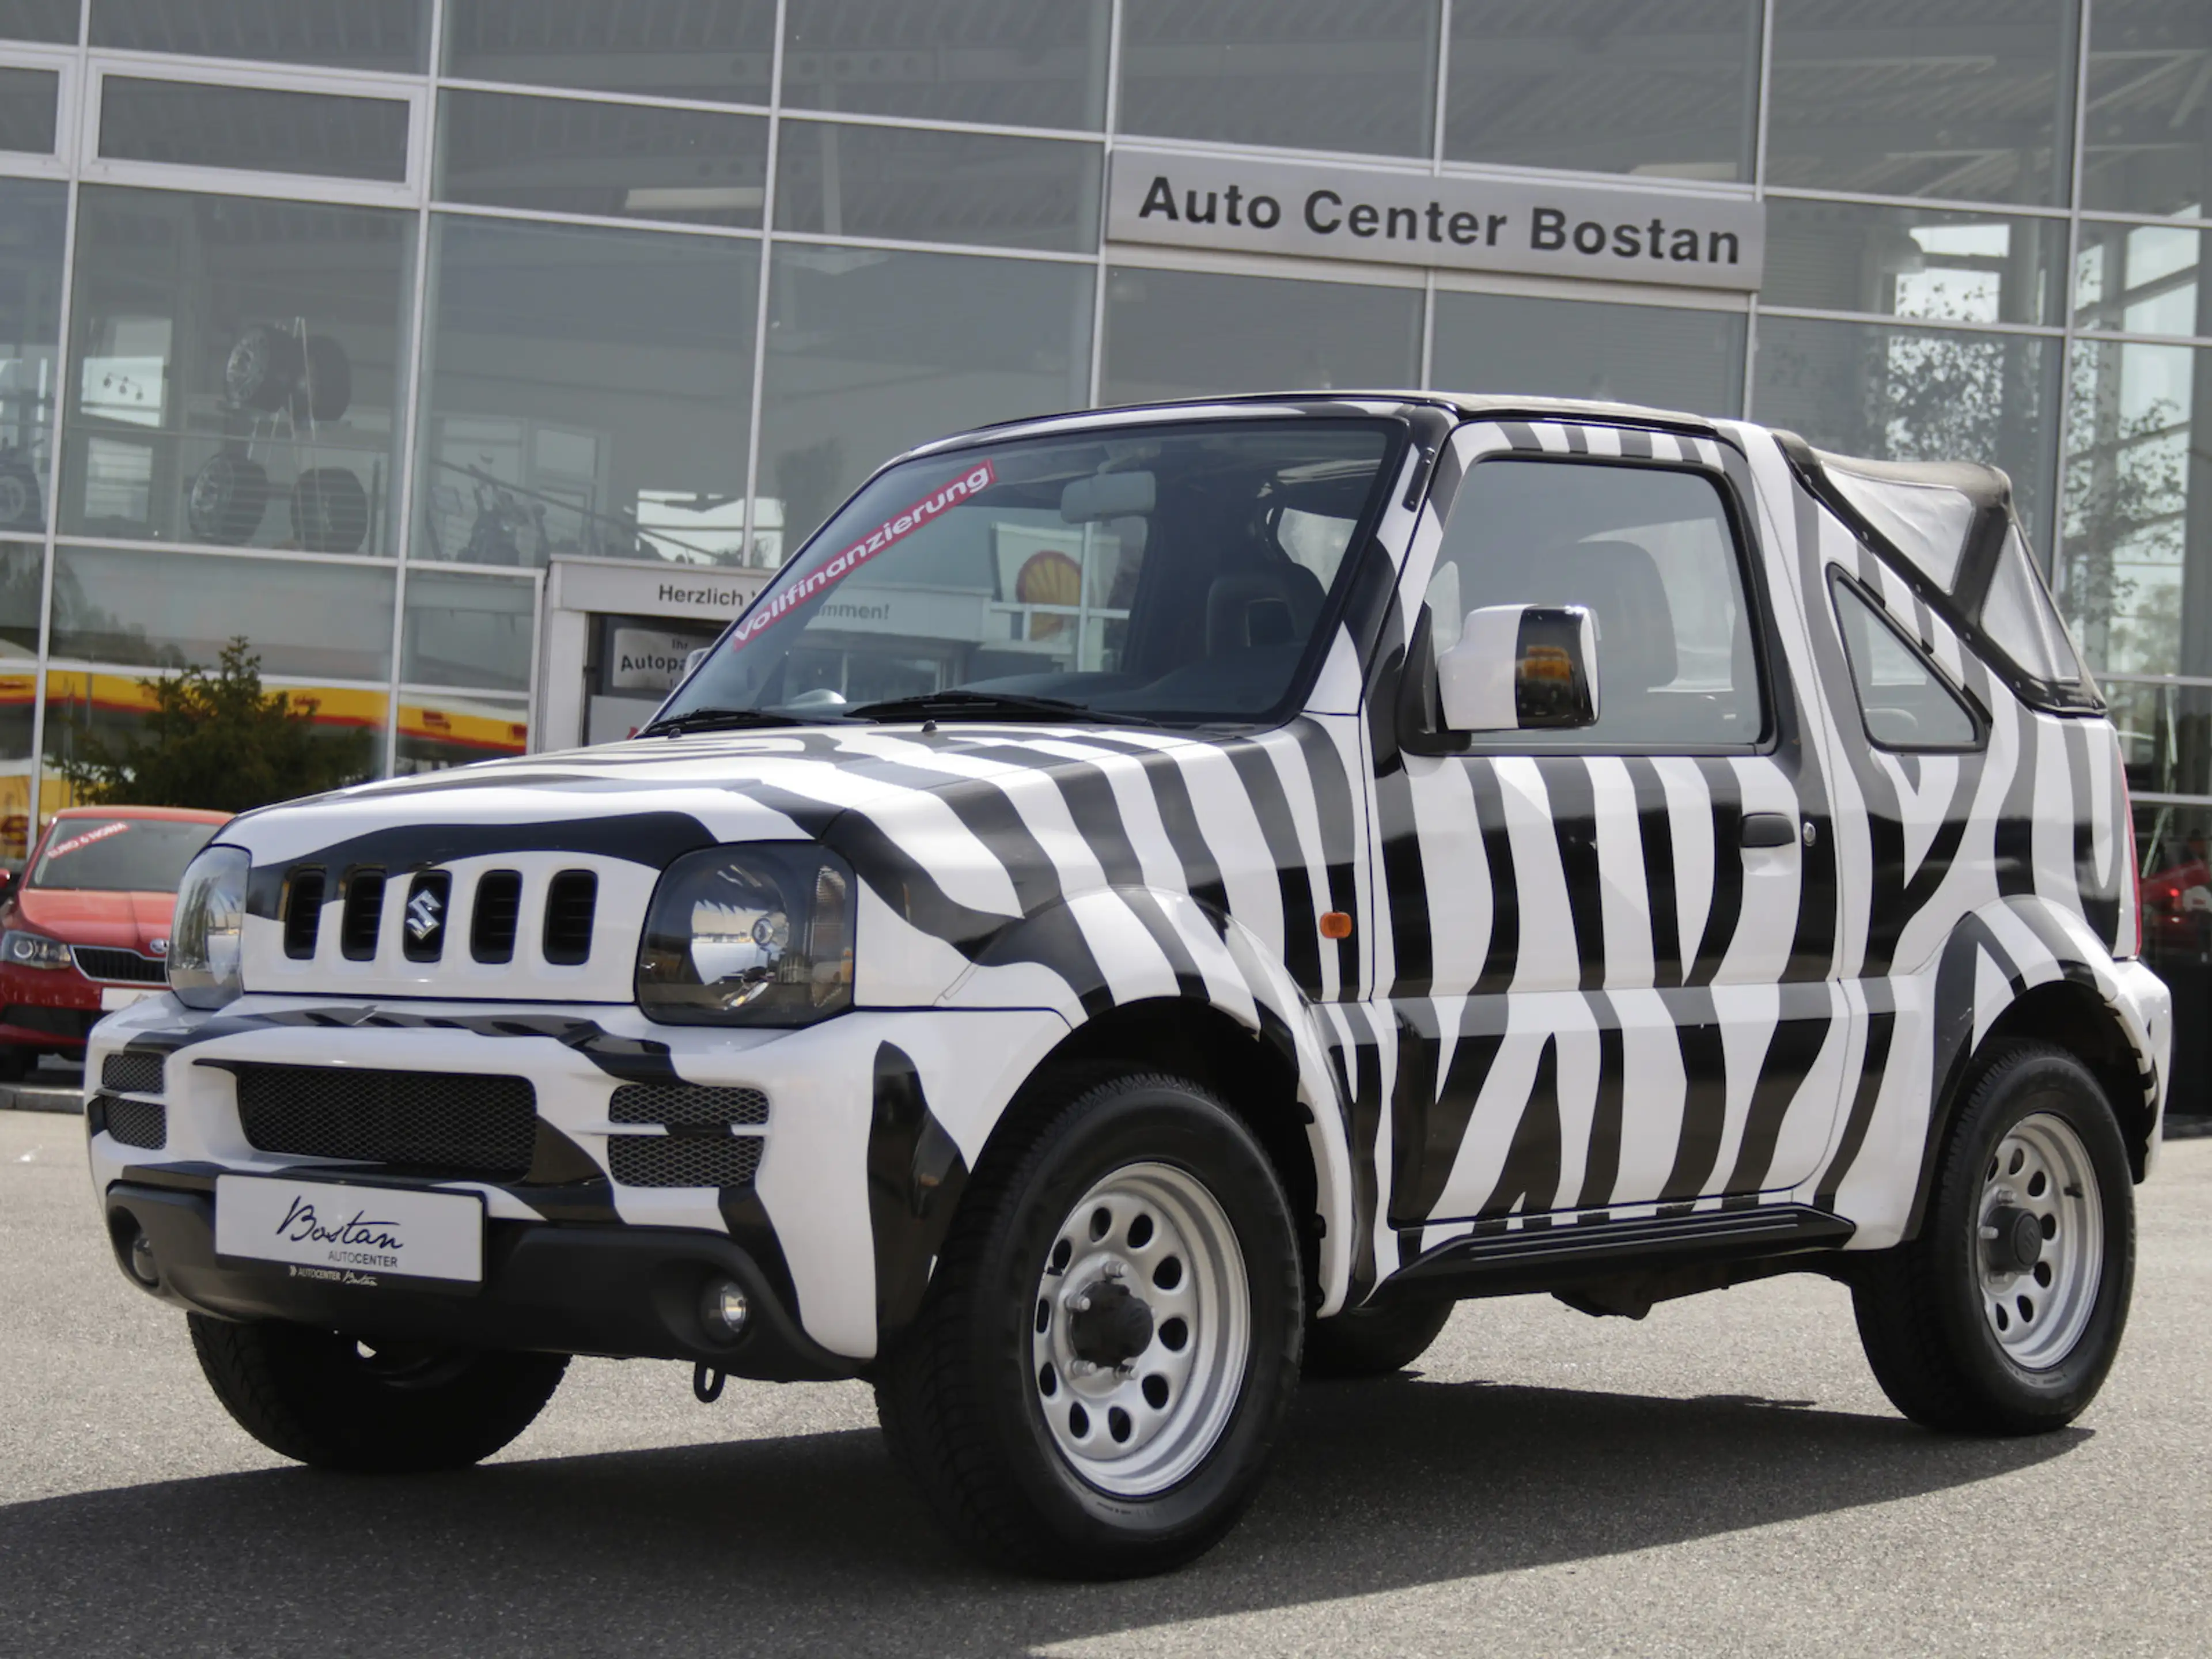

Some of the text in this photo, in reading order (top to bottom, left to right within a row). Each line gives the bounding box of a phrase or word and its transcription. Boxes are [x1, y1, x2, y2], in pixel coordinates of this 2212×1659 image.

[1139, 176, 1740, 264] Auto Center Bostan
[734, 467, 990, 642] Vollfinanzierung
[658, 584, 743, 606] Herzlich
[276, 1194, 404, 1249] Bostan
[327, 1250, 399, 1268] AUTOCENTER
